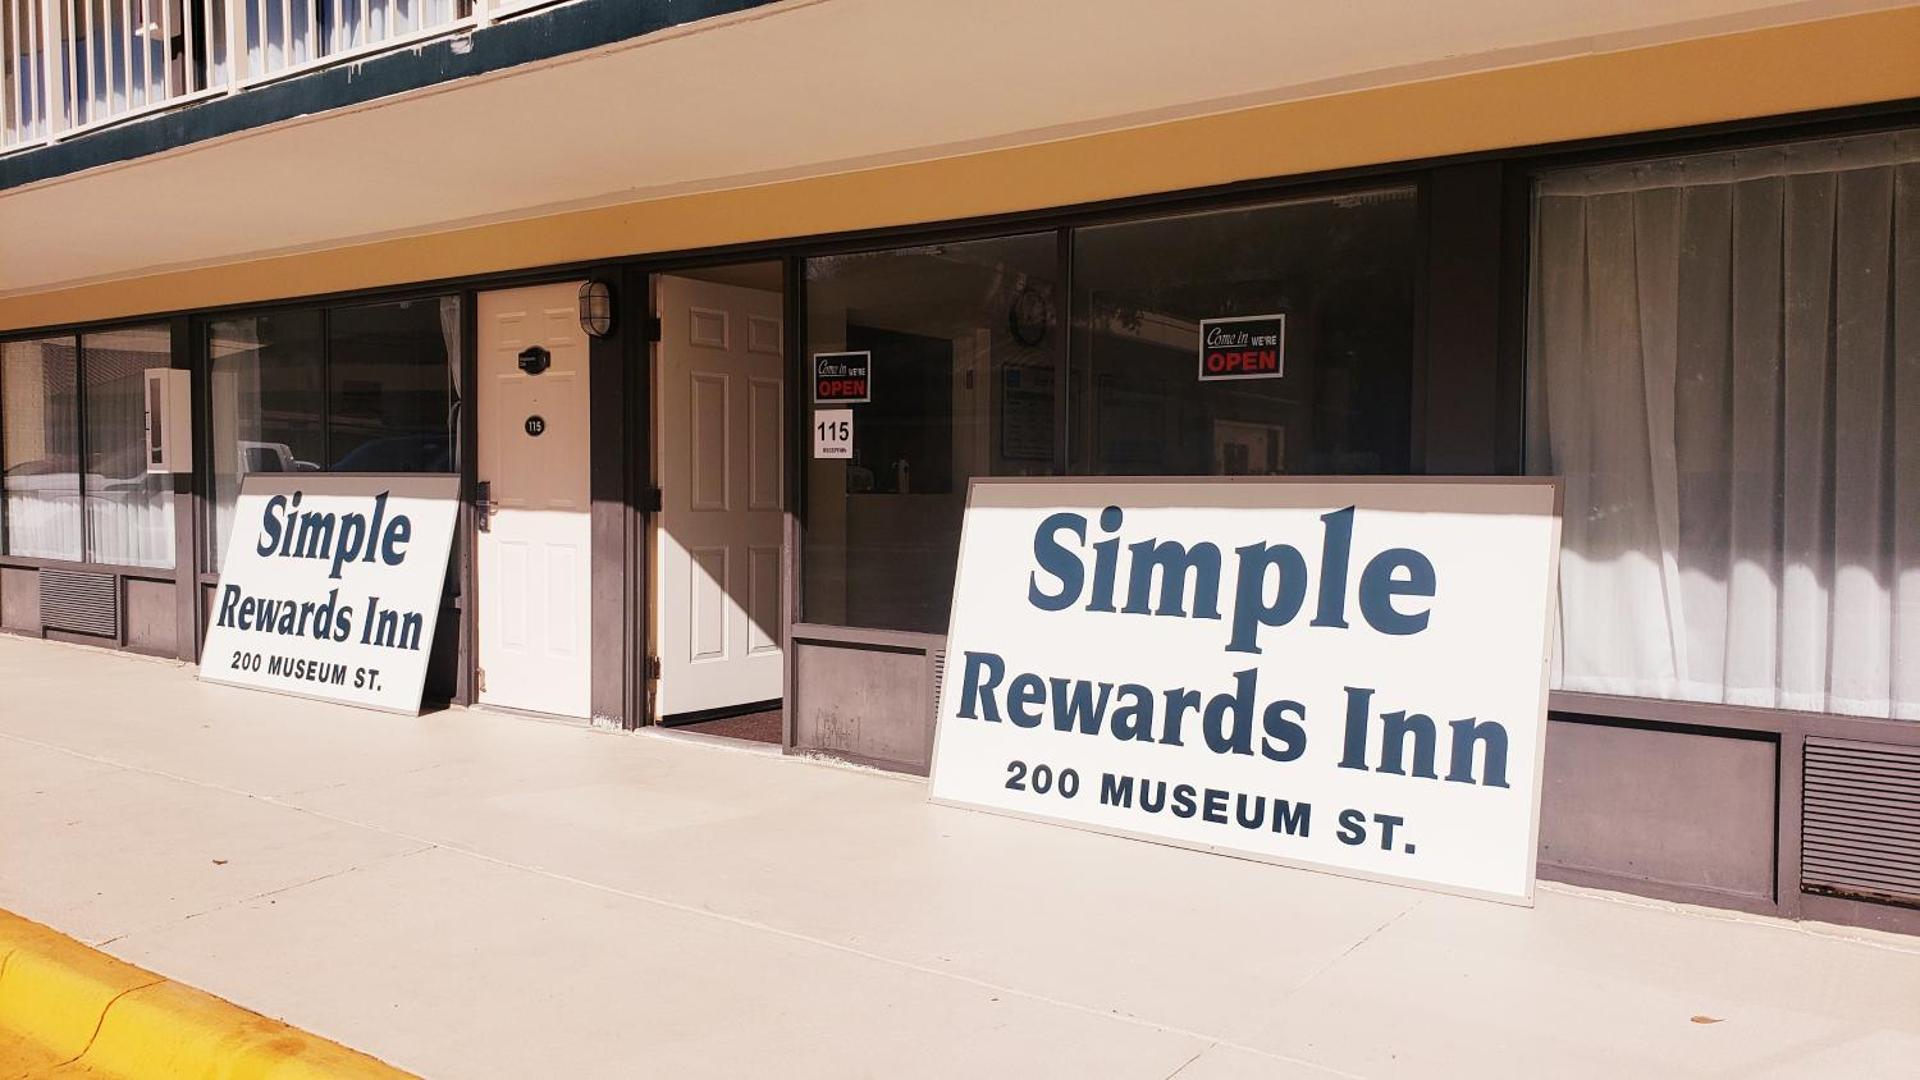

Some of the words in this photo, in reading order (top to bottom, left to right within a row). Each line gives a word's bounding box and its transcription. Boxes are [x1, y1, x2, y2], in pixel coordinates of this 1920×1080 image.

[1207, 327, 1236, 346] Come
[1237, 330, 1249, 344] in
[1251, 335, 1277, 346] WE'RE
[1207, 351, 1276, 372] OPEN
[819, 379, 865, 396] OPEN
[528, 421, 542, 432] 115
[817, 421, 849, 441] 115
[256, 490, 412, 579] Simple
[1028, 505, 1436, 654] Simple
[217, 584, 353, 642] Rewards
[360, 596, 424, 651] Inn
[231, 651, 262, 672] 200
[267, 655, 348, 686] MUSEUM
[353, 668, 382, 691] ST.
[956, 650, 1307, 762] Rewards
[1337, 686, 1510, 789] Inn
[1005, 760, 1080, 799] 200
[1100, 773, 1311, 838] MUSEUM
[1336, 808, 1416, 855] ST.
